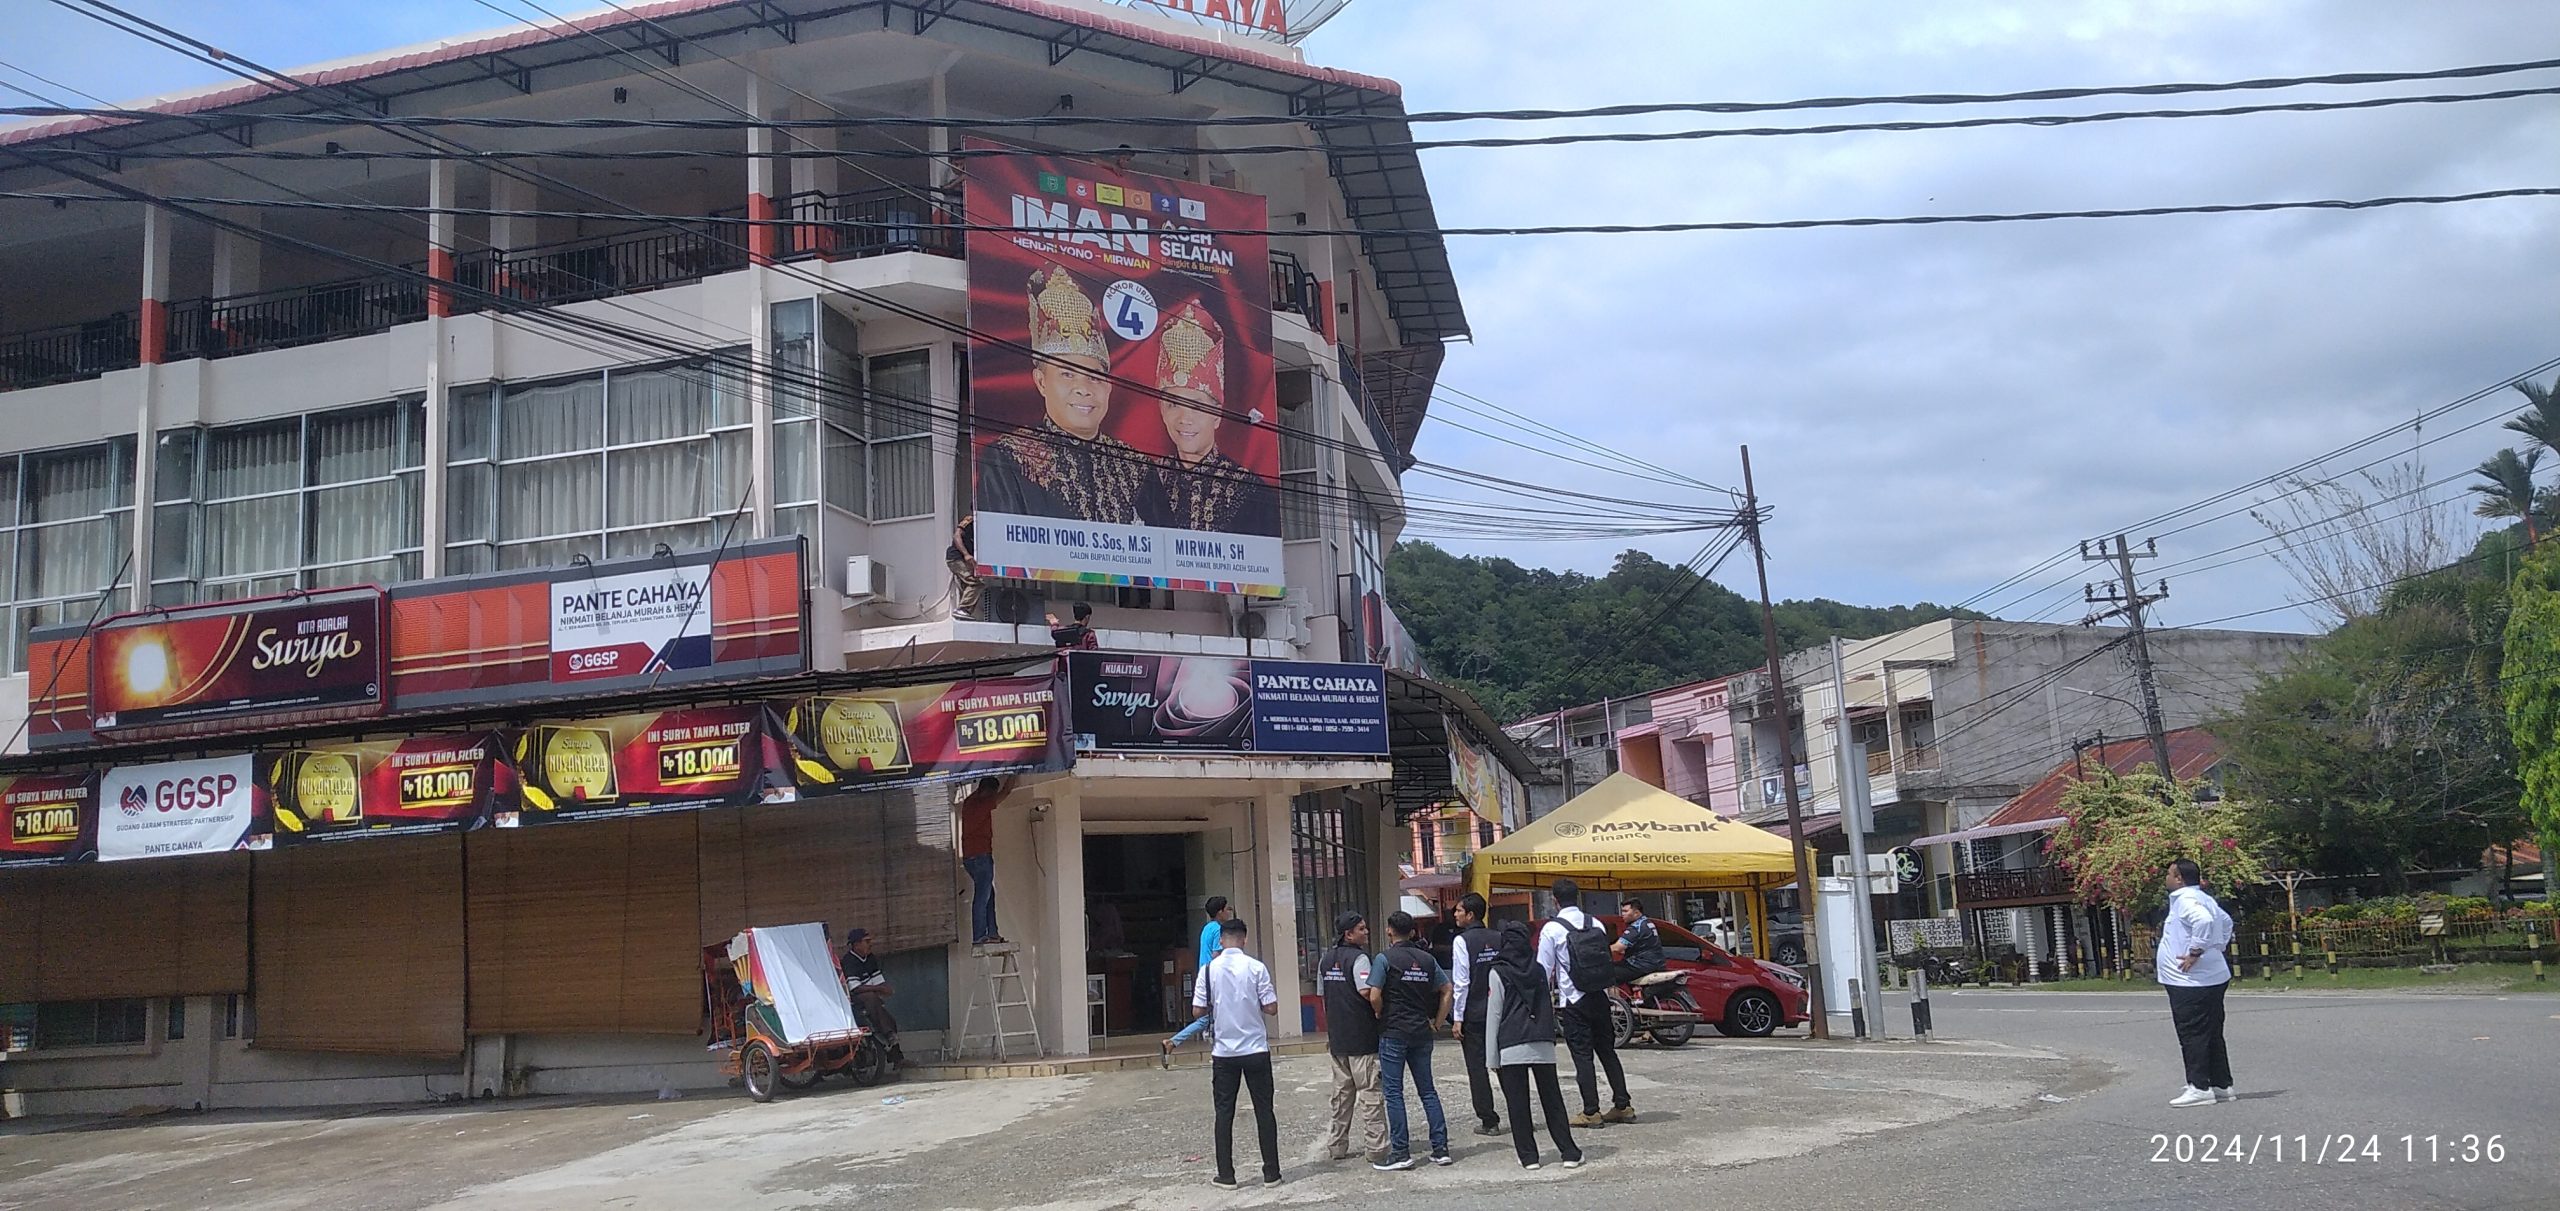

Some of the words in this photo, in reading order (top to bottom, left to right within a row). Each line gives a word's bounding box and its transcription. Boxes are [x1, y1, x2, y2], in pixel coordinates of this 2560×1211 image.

[1166, 0, 1287, 34] AYA
[1012, 193, 1149, 256] IMAN
[1013, 236, 1058, 254] HENDRI
[1059, 244, 1094, 260] YONO
[1103, 252, 1150, 270] MIRWAN
[1160, 240, 1234, 267] SELATAN
[1161, 257, 1190, 269] Bangkit
[1191, 261, 1199, 270] &
[1105, 282, 1134, 300] NOMOR
[1135, 286, 1155, 306] URUT
[1117, 294, 1144, 336] 4
[1006, 524, 1051, 545] HENDRI
[1054, 528, 1089, 548] YONO.
[1092, 532, 1125, 553] S.Sos,
[1128, 535, 1152, 553] M.Si
[1069, 551, 1089, 560] CALON
[1091, 553, 1111, 562] BUPATI
[1112, 554, 1127, 563] ACEH
[1128, 555, 1152, 564] SELATAN
[1175, 539, 1226, 560] MIRWAN,
[1230, 543, 1245, 560] SH
[1176, 559, 1194, 568] CALON
[1195, 560, 1211, 570] WAKIL
[1212, 562, 1231, 571] BUPATI
[1232, 564, 1247, 572] ACEH
[1247, 565, 1270, 573] SELATAN
[563, 590, 622, 614] PANTE
[627, 581, 700, 606] CAHAYA
[560, 614, 594, 626] NIKMATI
[595, 610, 633, 622] BELANJA
[634, 605, 664, 617] MURAH
[666, 605, 672, 613] &
[673, 601, 703, 613] HEMAT
[297, 619, 315, 635] KITA
[317, 615, 349, 633] ADALAH
[252, 628, 362, 678] Surya
[584, 651, 618, 666] GGSP
[1105, 664, 1143, 675] KUALITAS
[1257, 675, 1311, 690] PANTE
[1313, 677, 1378, 692] CAHAYA
[941, 700, 956, 712] INI
[958, 697, 989, 711] SURYA
[991, 693, 1022, 707] TANPA
[1023, 690, 1054, 704] FILTER
[1092, 683, 1159, 717] Surya
[1257, 692, 1288, 701] NIKMATI
[1290, 693, 1320, 702] BELANJA
[1321, 694, 1347, 703] MURAH
[1349, 695, 1355, 703] &
[1356, 695, 1380, 704] HEMAT
[839, 707, 876, 724] Surya
[647, 731, 660, 743] INI
[662, 728, 691, 741] SURYA
[693, 724, 720, 739] TANPA
[722, 722, 750, 736] FILTER
[825, 725, 895, 745] NUSANTARA
[562, 737, 592, 754] Surya
[392, 755, 403, 768] INI
[405, 752, 431, 766] SURYA
[432, 750, 457, 764] TANPA
[457, 748, 485, 762] FILTER
[549, 753, 606, 773] NUSANTARA
[5, 793, 15, 805] INI
[17, 792, 39, 803] SURYA
[41, 789, 63, 801] TANPA
[64, 787, 88, 799] FILTER
[155, 773, 238, 813] GGSP
[300, 777, 353, 796] NUSANTARA
[116, 824, 140, 832] GUDANG
[141, 822, 162, 830] GARAM
[163, 819, 194, 827] STRATEGIC
[195, 814, 234, 825] PARTNERSHIP
[1591, 820, 1719, 834] Maybank
[145, 843, 171, 854] PANTE
[172, 841, 203, 852] CAHAYA
[1592, 832, 1651, 843] Finance
[1491, 854, 1568, 866] Humanising
[1572, 852, 1627, 864] Financial
[1632, 852, 1691, 864] Services.
